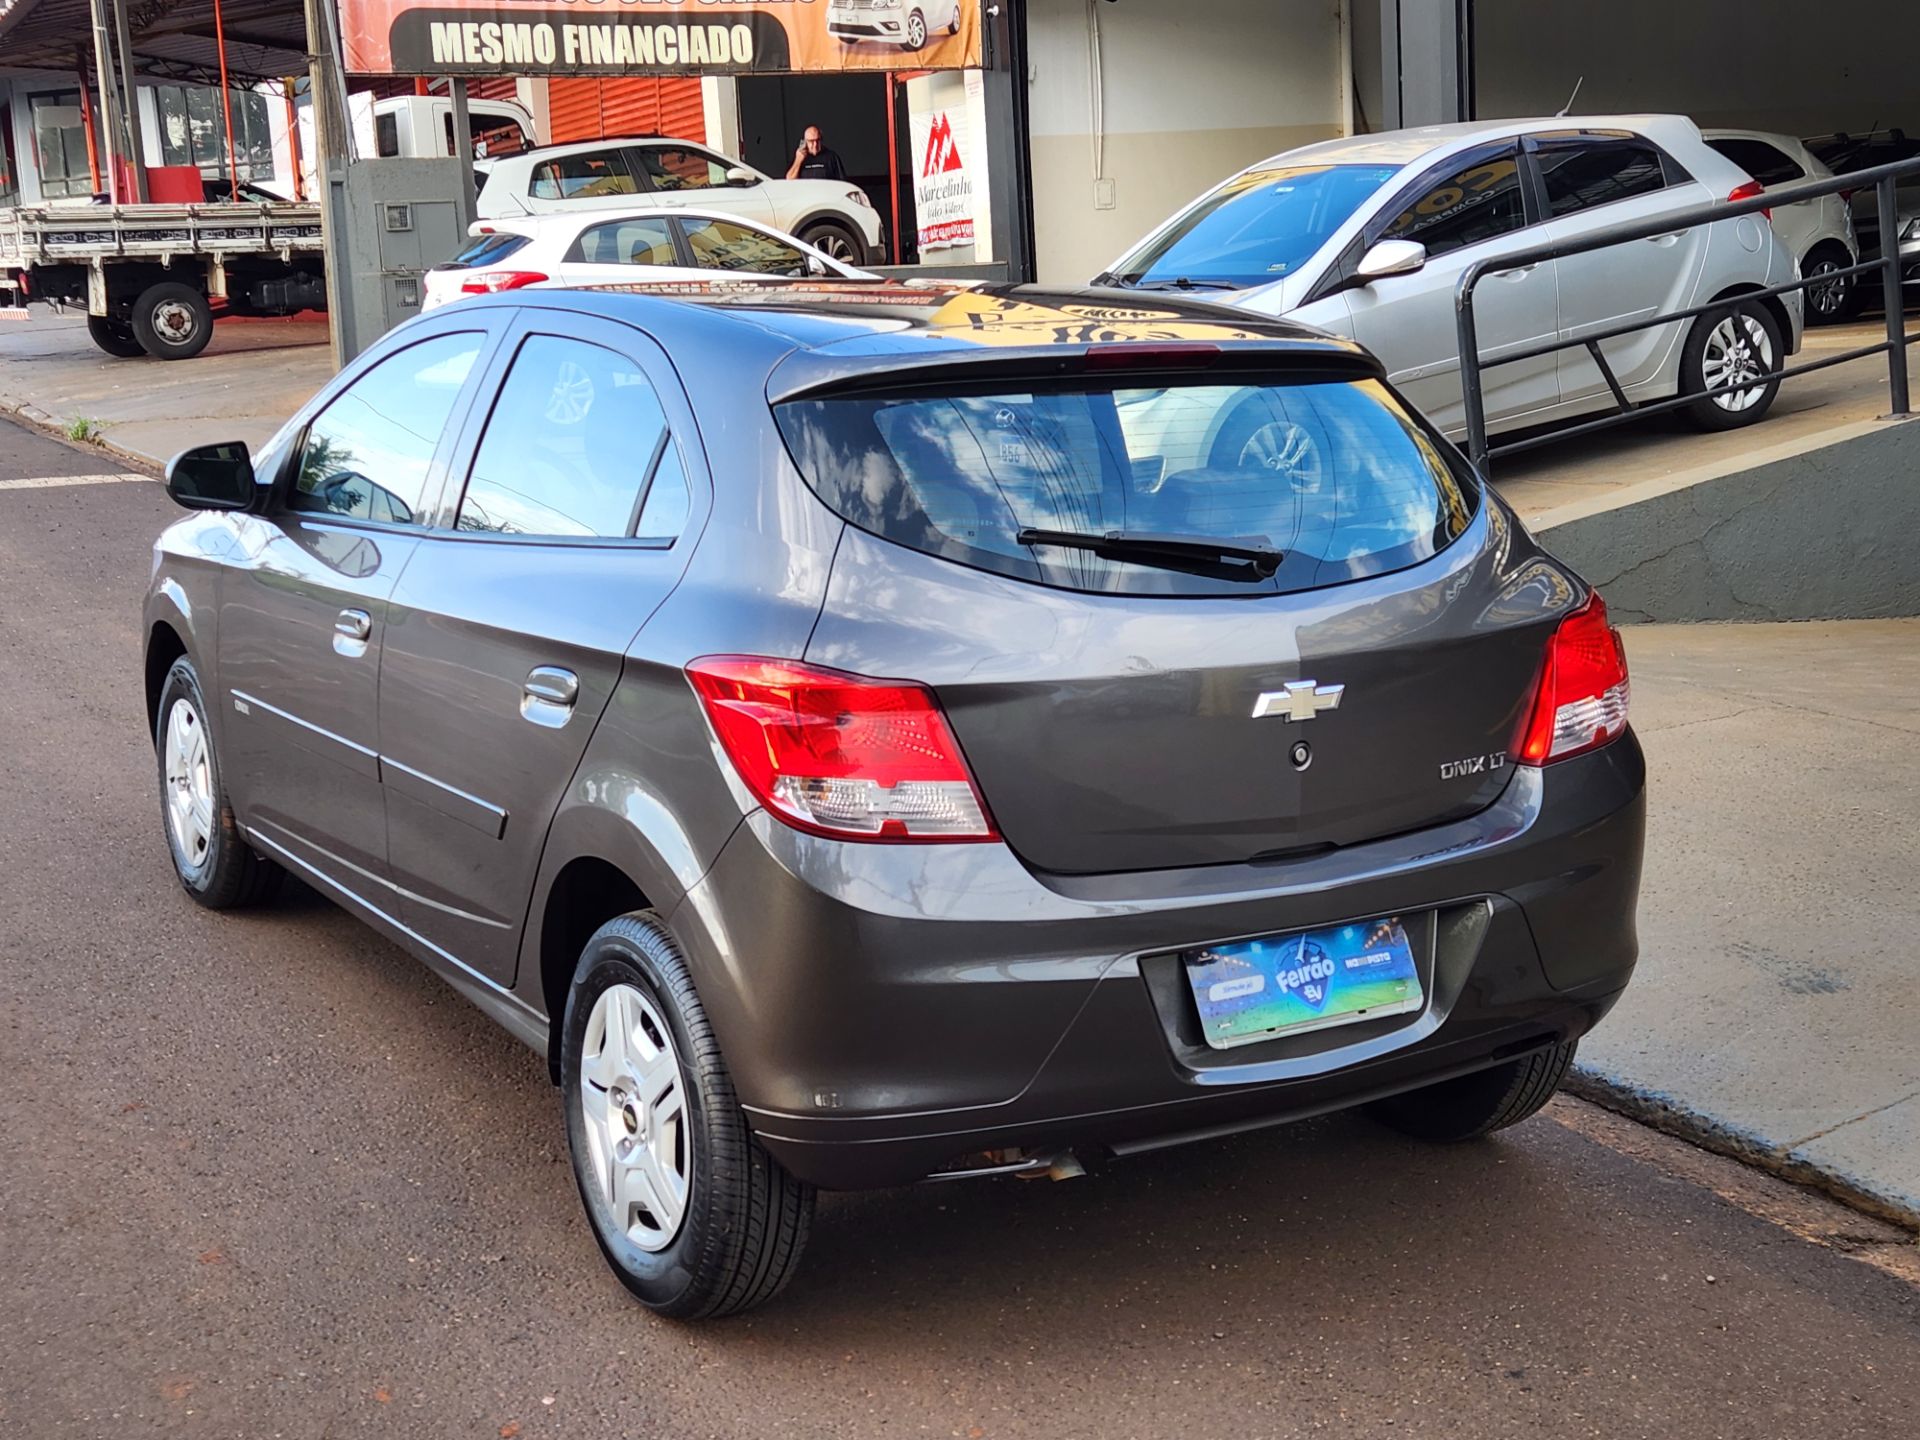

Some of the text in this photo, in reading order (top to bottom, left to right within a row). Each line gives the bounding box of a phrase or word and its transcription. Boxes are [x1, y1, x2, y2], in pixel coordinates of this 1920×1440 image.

[430, 22, 754, 65] MESMO FINANCIADO
[1440, 751, 1507, 780] ONIX LT
[1275, 955, 1335, 994] Feirão
